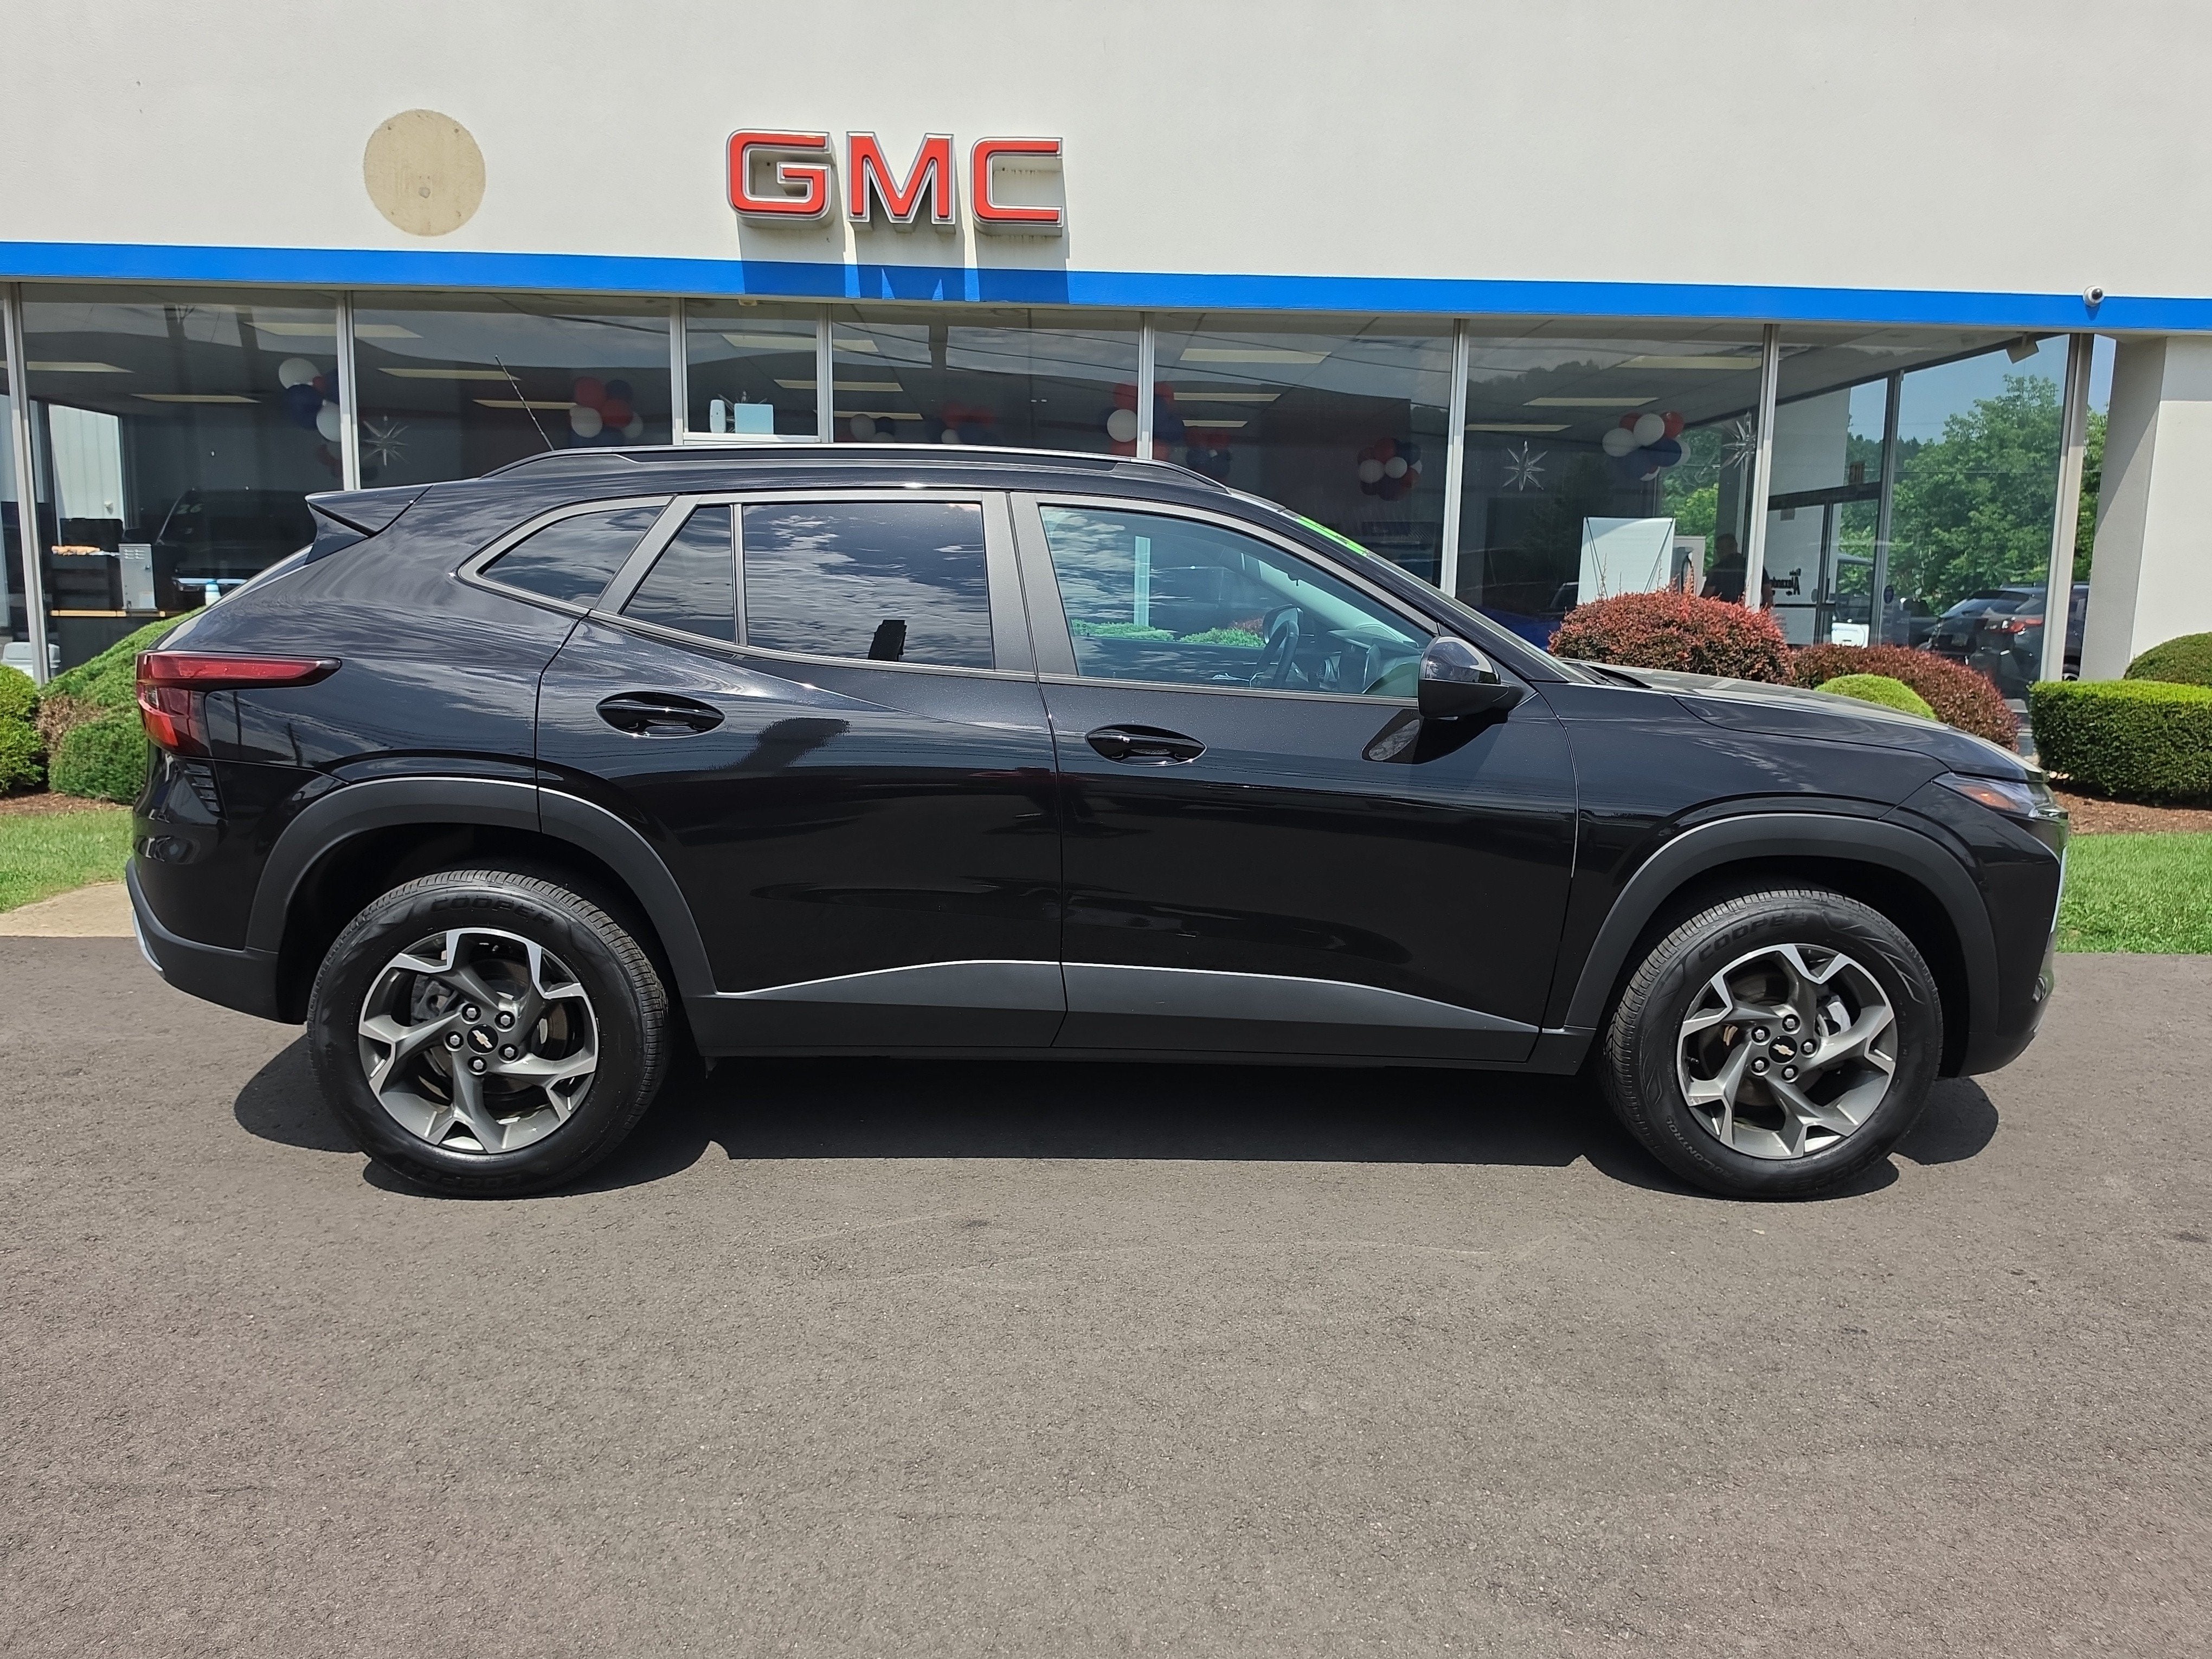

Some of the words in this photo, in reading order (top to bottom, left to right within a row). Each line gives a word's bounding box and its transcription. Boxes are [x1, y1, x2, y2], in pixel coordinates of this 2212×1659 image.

[726, 128, 1063, 227] GMC
[431, 898, 553, 925] COOPER
[1699, 914, 1808, 962] COOPER
